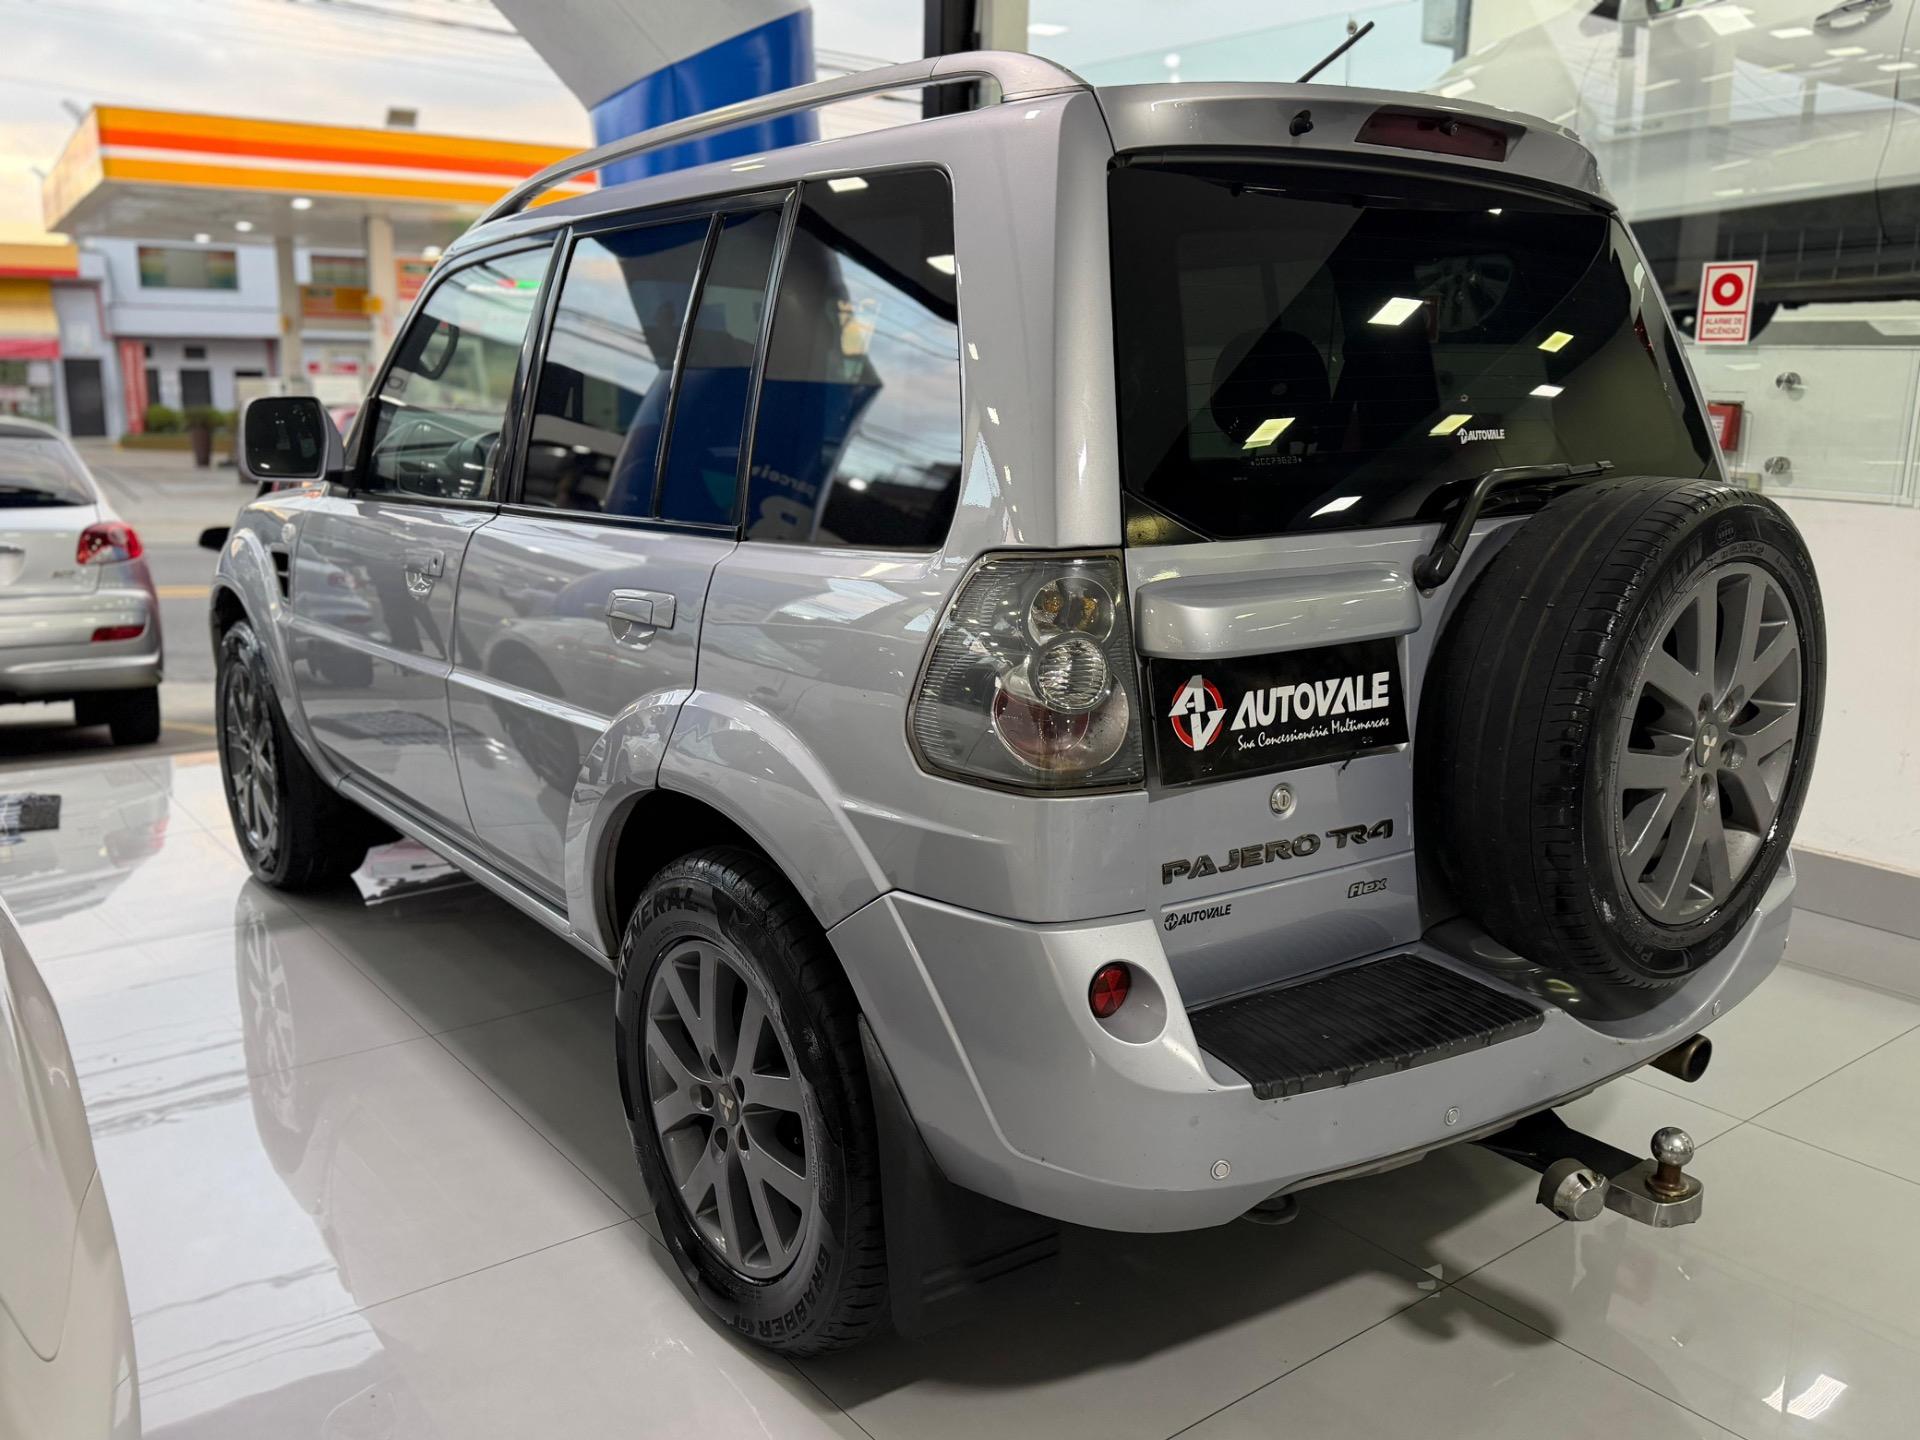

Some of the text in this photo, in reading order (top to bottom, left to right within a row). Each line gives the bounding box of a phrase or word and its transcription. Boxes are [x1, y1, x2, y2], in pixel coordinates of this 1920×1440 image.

[1468, 429, 1505, 440] AUTOVALE
[1230, 671, 1390, 731] AUTOVALE
[1237, 717, 1390, 751] Sua Concessionária Multimarcas
[1162, 818, 1394, 885] PAJERO TR4
[1178, 903, 1231, 925] AUTOVALE
[618, 887, 706, 990] GENERAL
